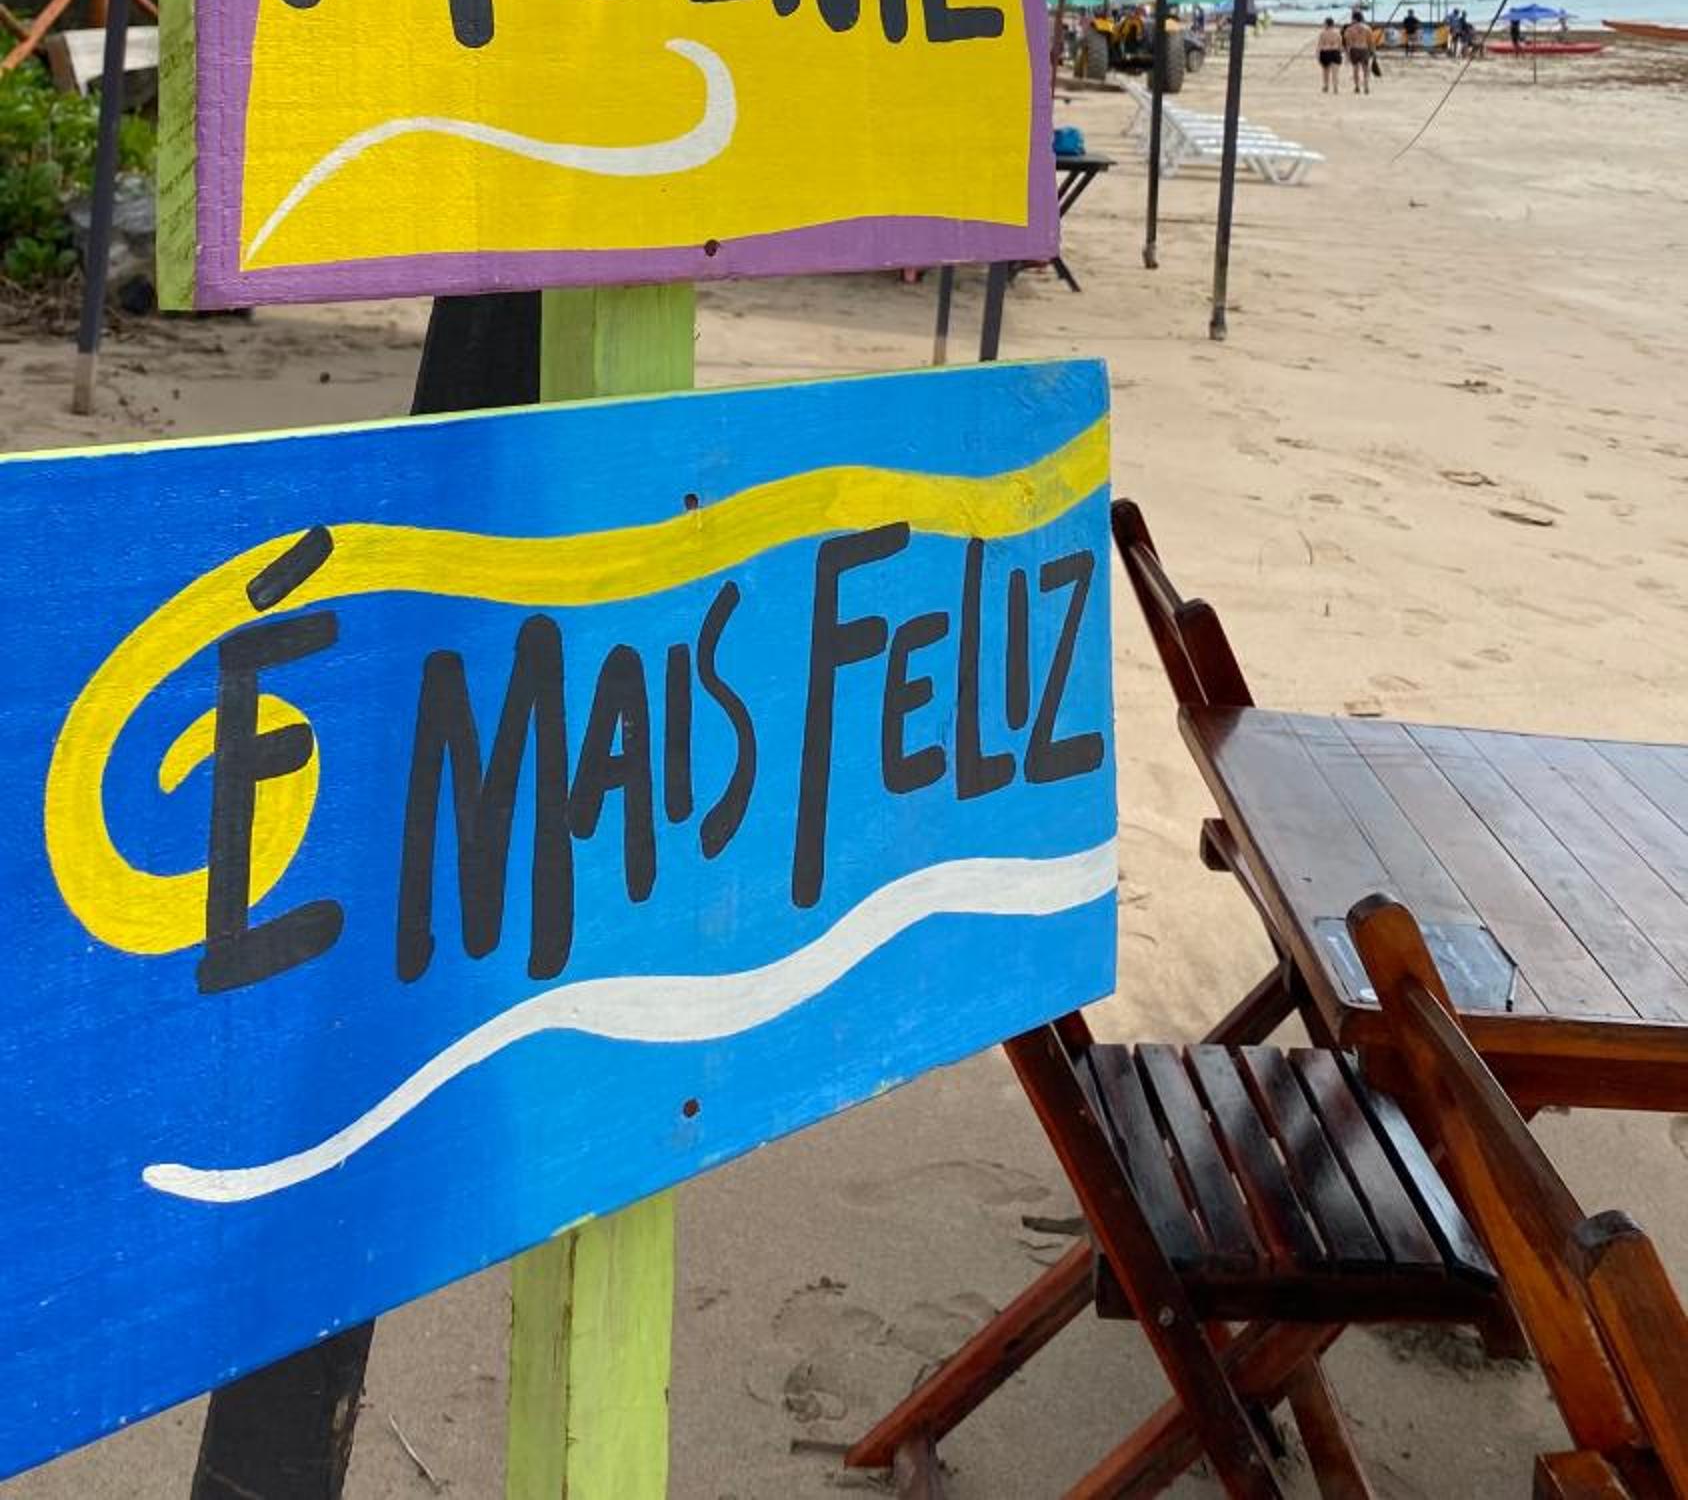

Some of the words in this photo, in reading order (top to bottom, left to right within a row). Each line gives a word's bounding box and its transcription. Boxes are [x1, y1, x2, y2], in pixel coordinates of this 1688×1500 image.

[197, 524, 344, 994] É
[399, 580, 757, 982] MAIS
[792, 520, 1104, 908] FELIZ
